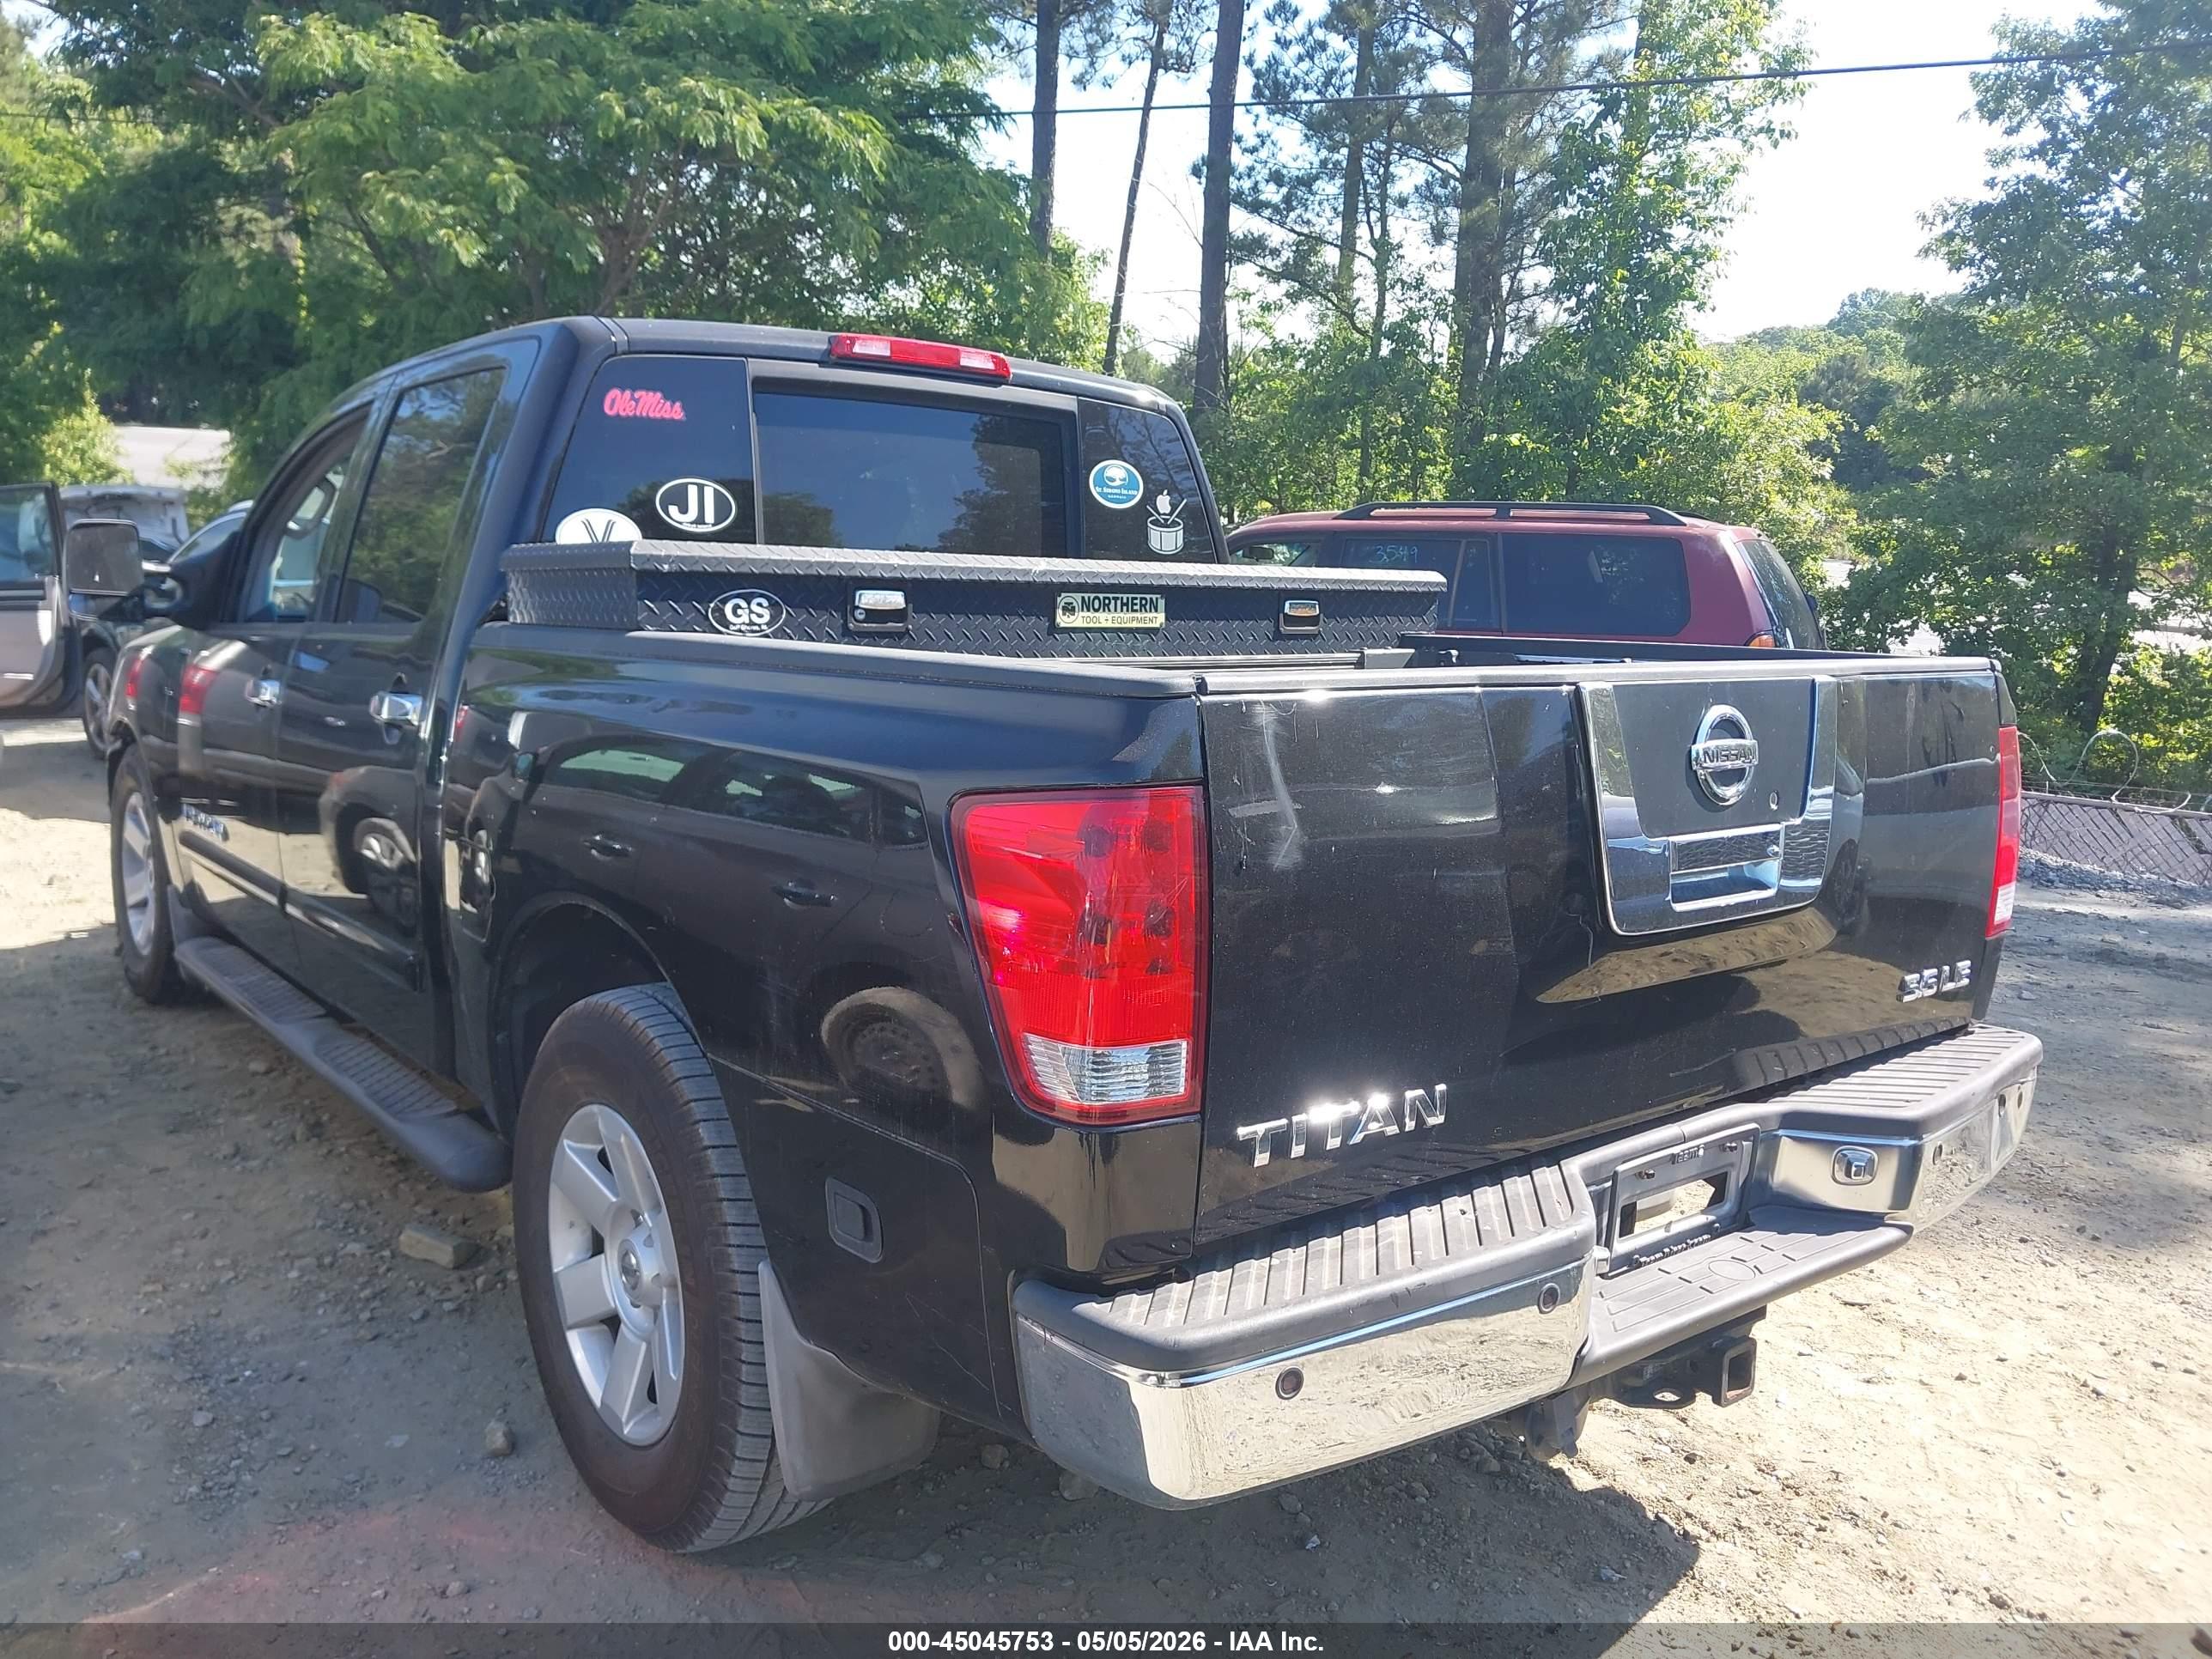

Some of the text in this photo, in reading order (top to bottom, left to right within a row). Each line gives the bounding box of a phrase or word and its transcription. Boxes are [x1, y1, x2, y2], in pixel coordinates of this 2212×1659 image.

[605, 387, 684, 419] Ole Miss
[667, 483, 714, 523] JI
[725, 597, 770, 624] GS
[1080, 595, 1159, 613] NORTHERN
[1081, 616, 1103, 625] TOOL
[1111, 616, 1158, 625] EQUIPMENT
[1703, 747, 1756, 764] NISSAN
[1237, 1083, 1447, 1168] TITAN
